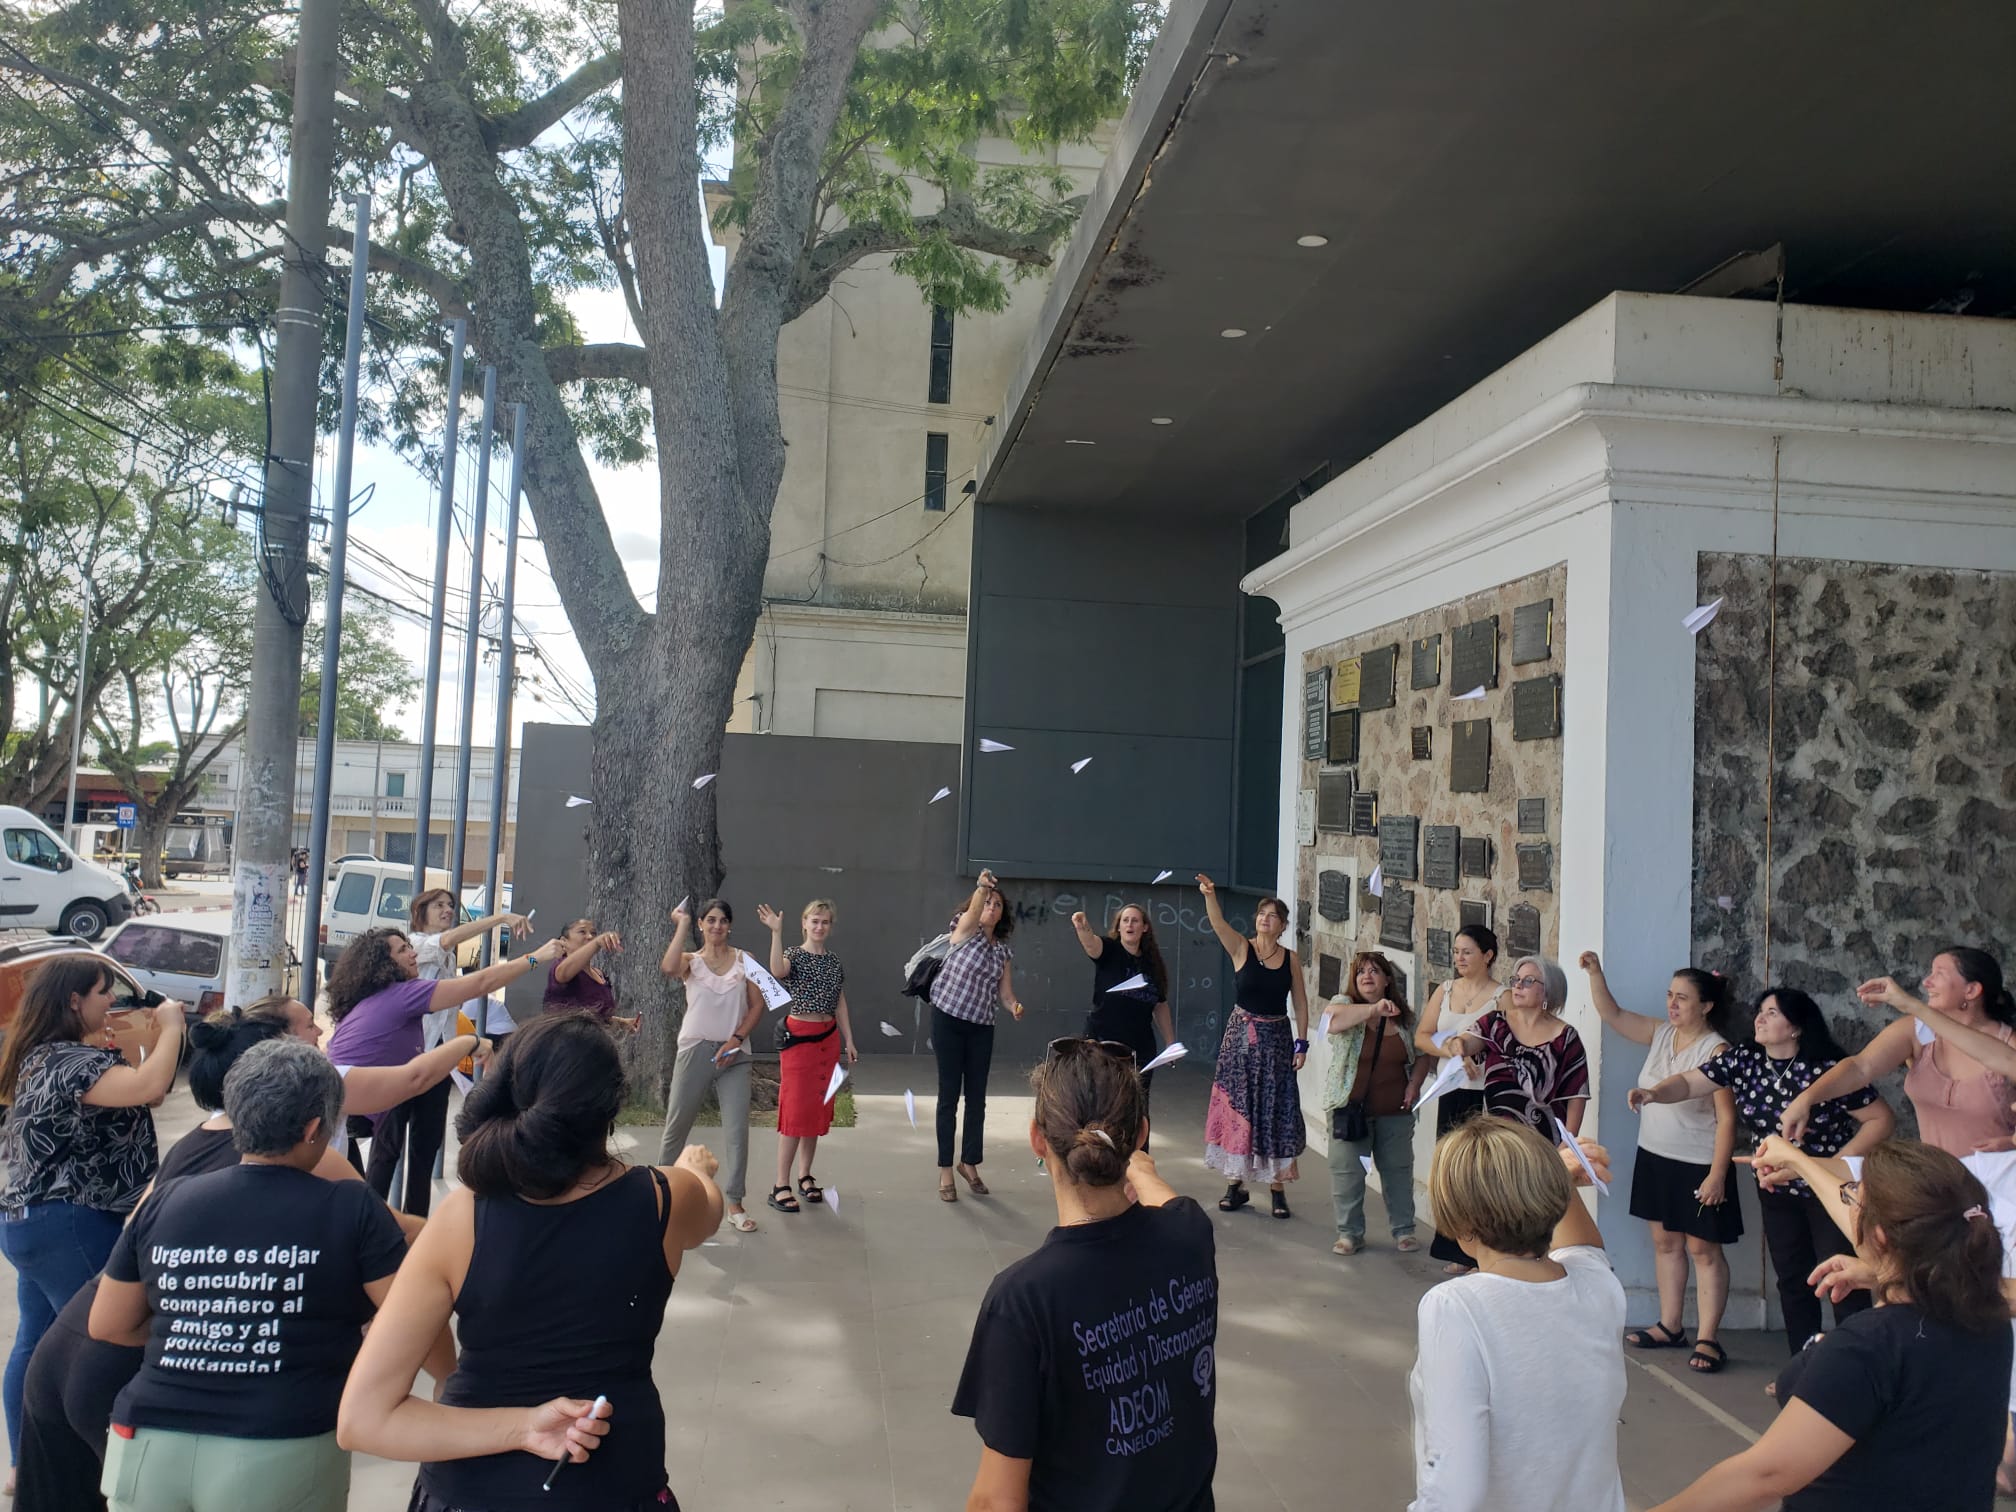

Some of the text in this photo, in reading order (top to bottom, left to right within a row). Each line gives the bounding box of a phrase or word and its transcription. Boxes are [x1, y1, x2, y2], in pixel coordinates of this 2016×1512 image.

[152, 1245, 320, 1269] Urgente es dejar
[158, 1272, 304, 1291] de encubrir al
[160, 1296, 303, 1316] compañero al
[1073, 1275, 1215, 1357] Secretaría de Género
[170, 1319, 279, 1340] amigo y al
[252, 1340, 281, 1354] de
[1082, 1344, 1139, 1394] Equidad
[1139, 1349, 1148, 1381] y
[1110, 1376, 1170, 1434] ADEOM
